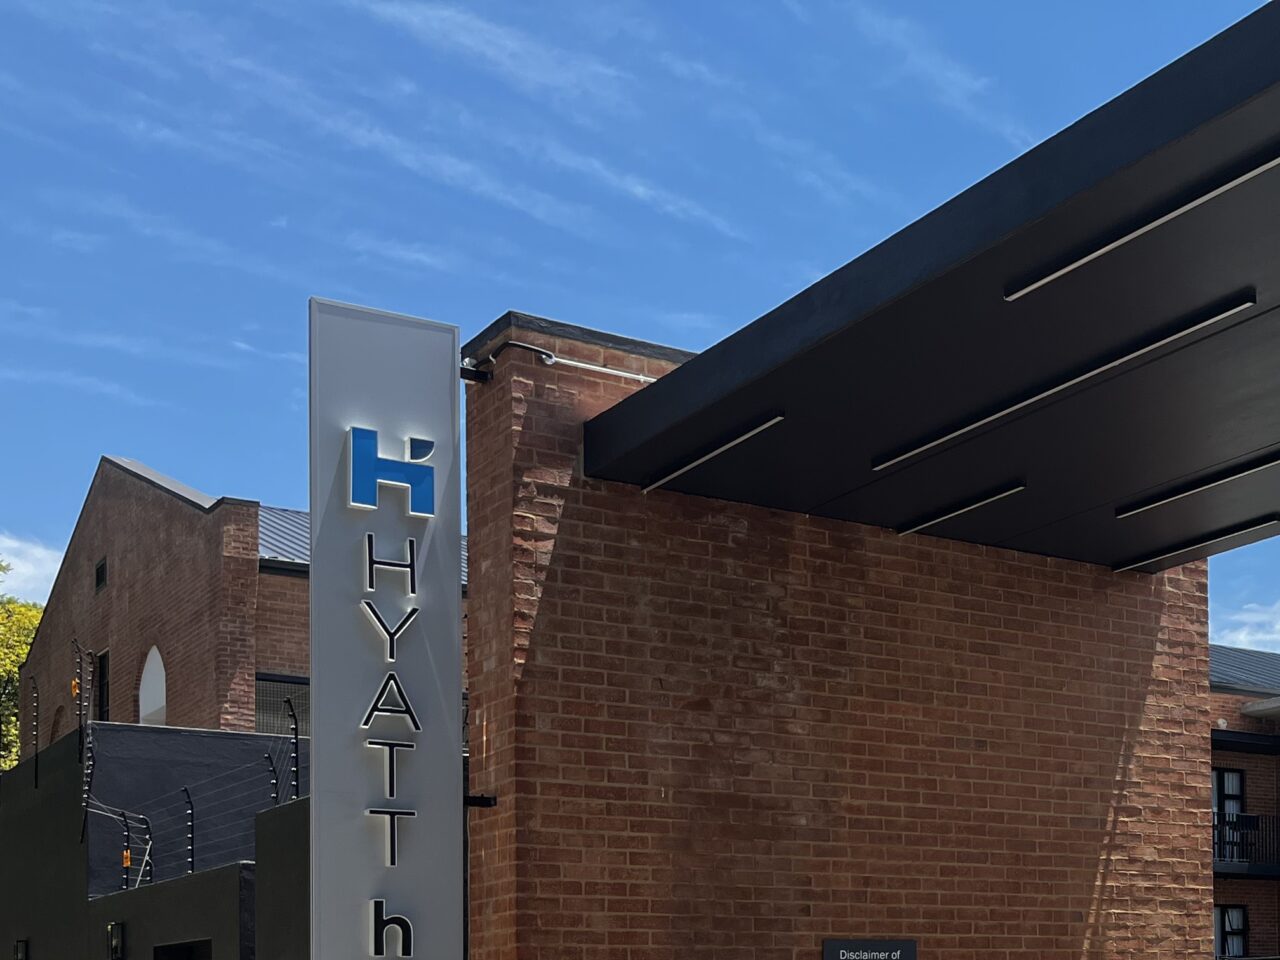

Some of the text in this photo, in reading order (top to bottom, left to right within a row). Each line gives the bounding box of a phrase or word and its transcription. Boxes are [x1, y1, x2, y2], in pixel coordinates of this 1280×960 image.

[360, 532, 422, 866] HYATT
[839, 949, 901, 960] Disclaimer of
